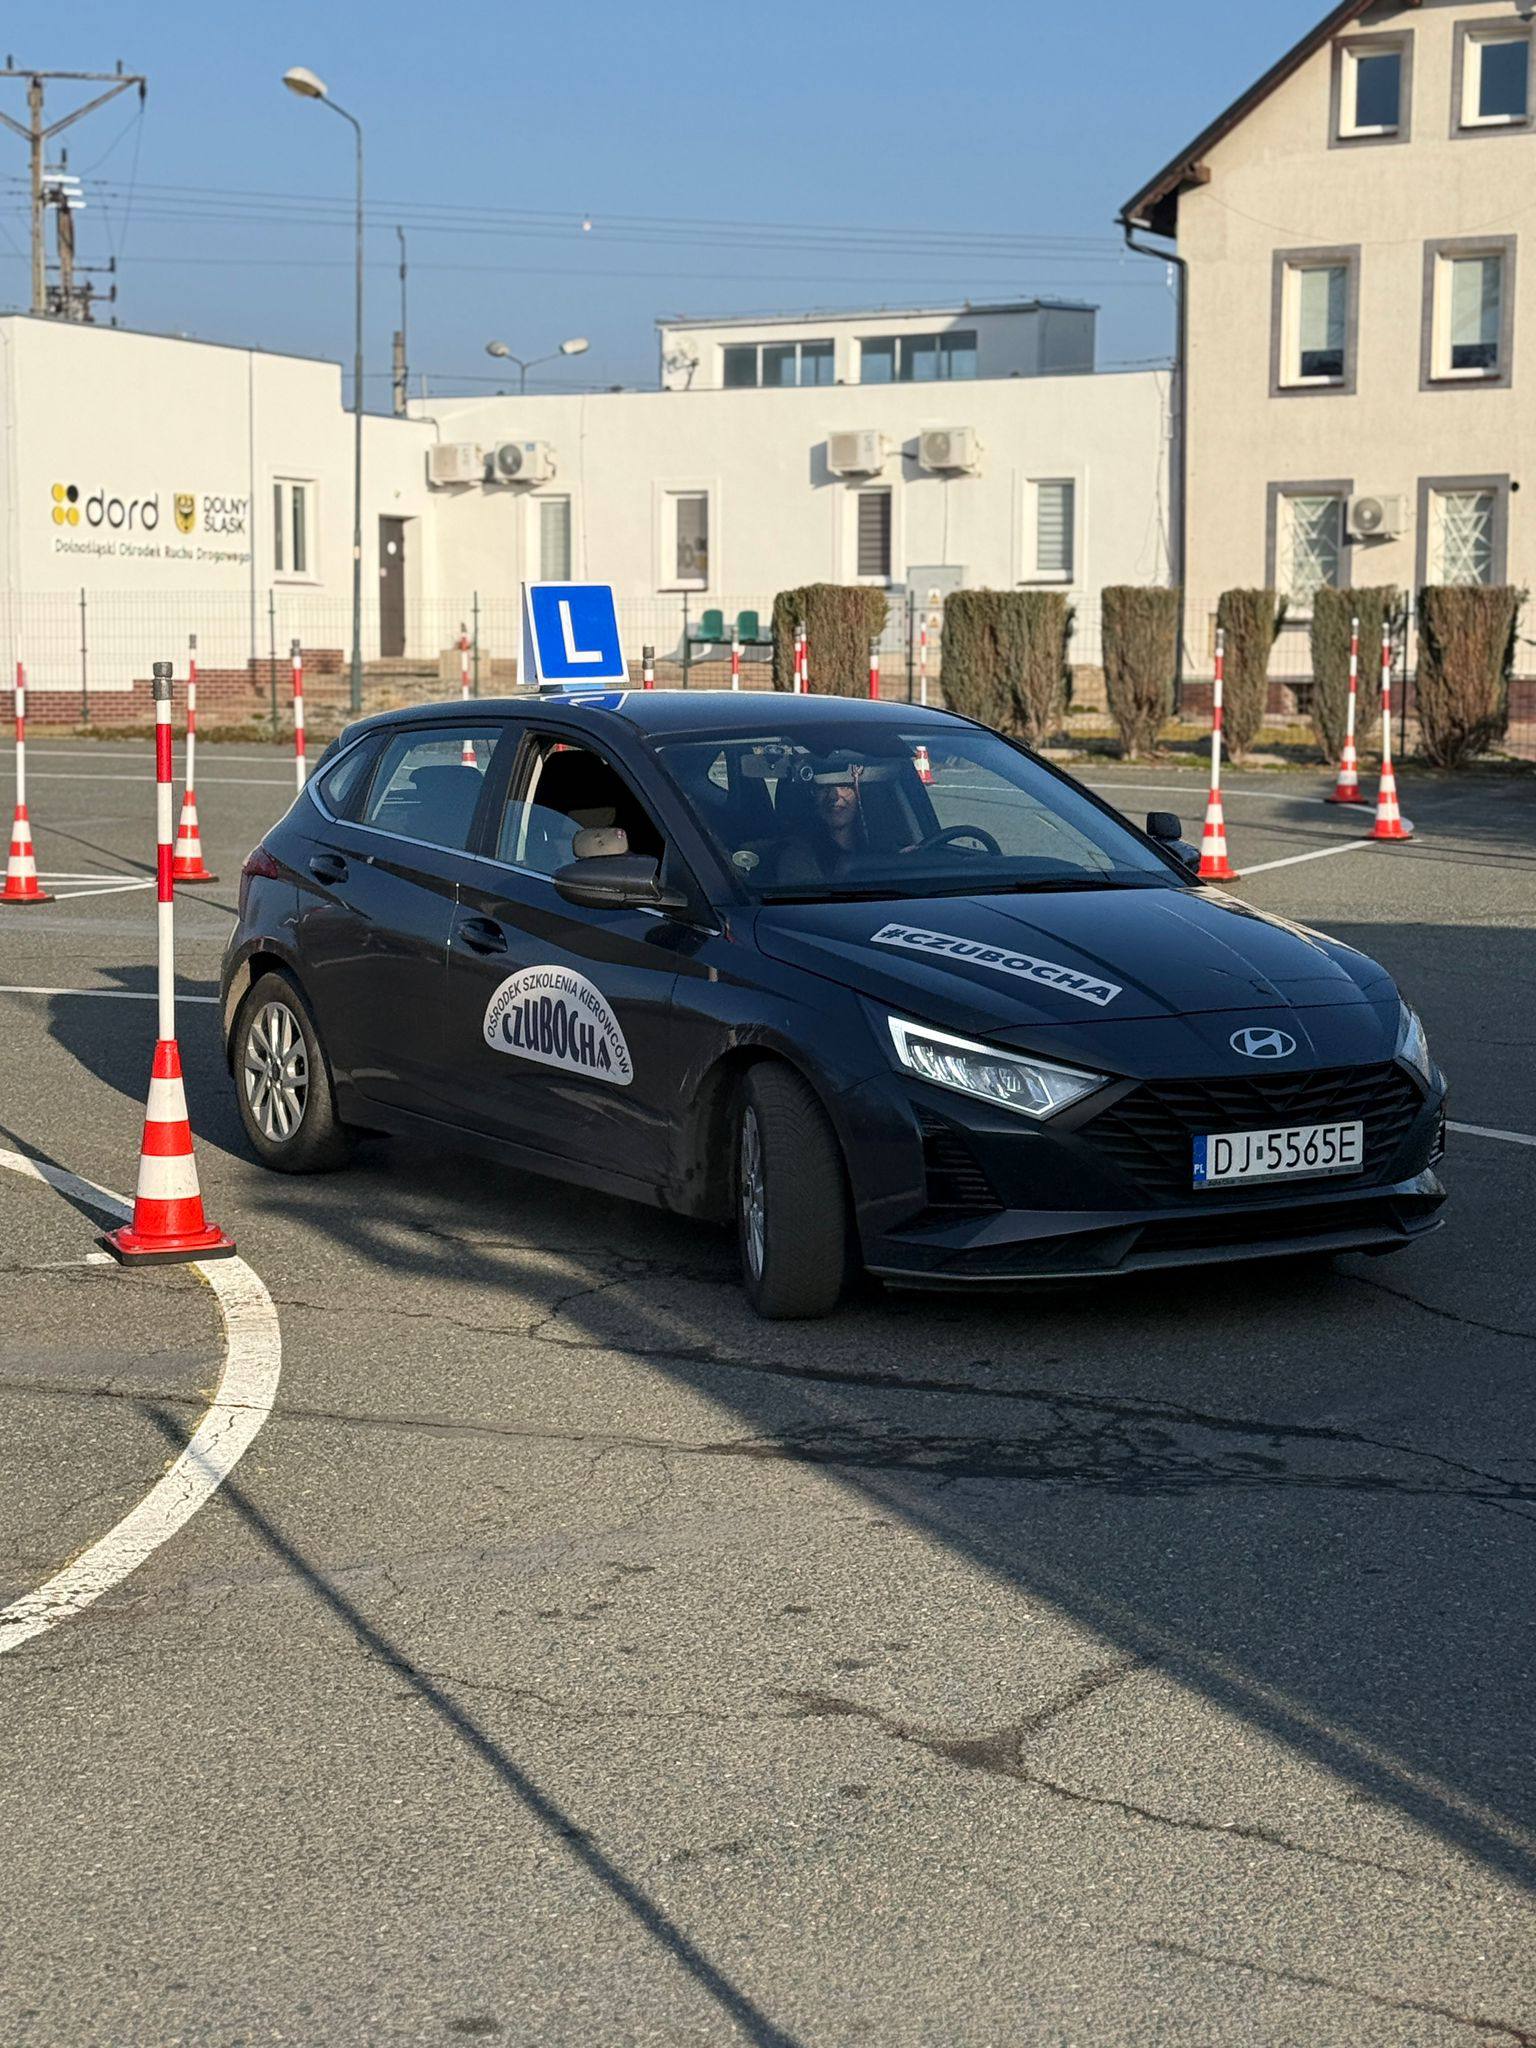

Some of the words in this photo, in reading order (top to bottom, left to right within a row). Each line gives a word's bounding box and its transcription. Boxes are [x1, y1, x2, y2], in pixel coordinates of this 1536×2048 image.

[86, 488, 159, 531] dord
[203, 496, 249, 515] DOLNY
[558, 600, 603, 664] L
[878, 928, 1112, 1001] #CZUBOCHA
[487, 980, 522, 1039] OŚRODEK
[522, 973, 578, 995] SZKOLENIA
[578, 986, 630, 1074] KIEROWCÓW
[501, 995, 612, 1073] CZUBOCHA
[1193, 1163, 1205, 1174] PL
